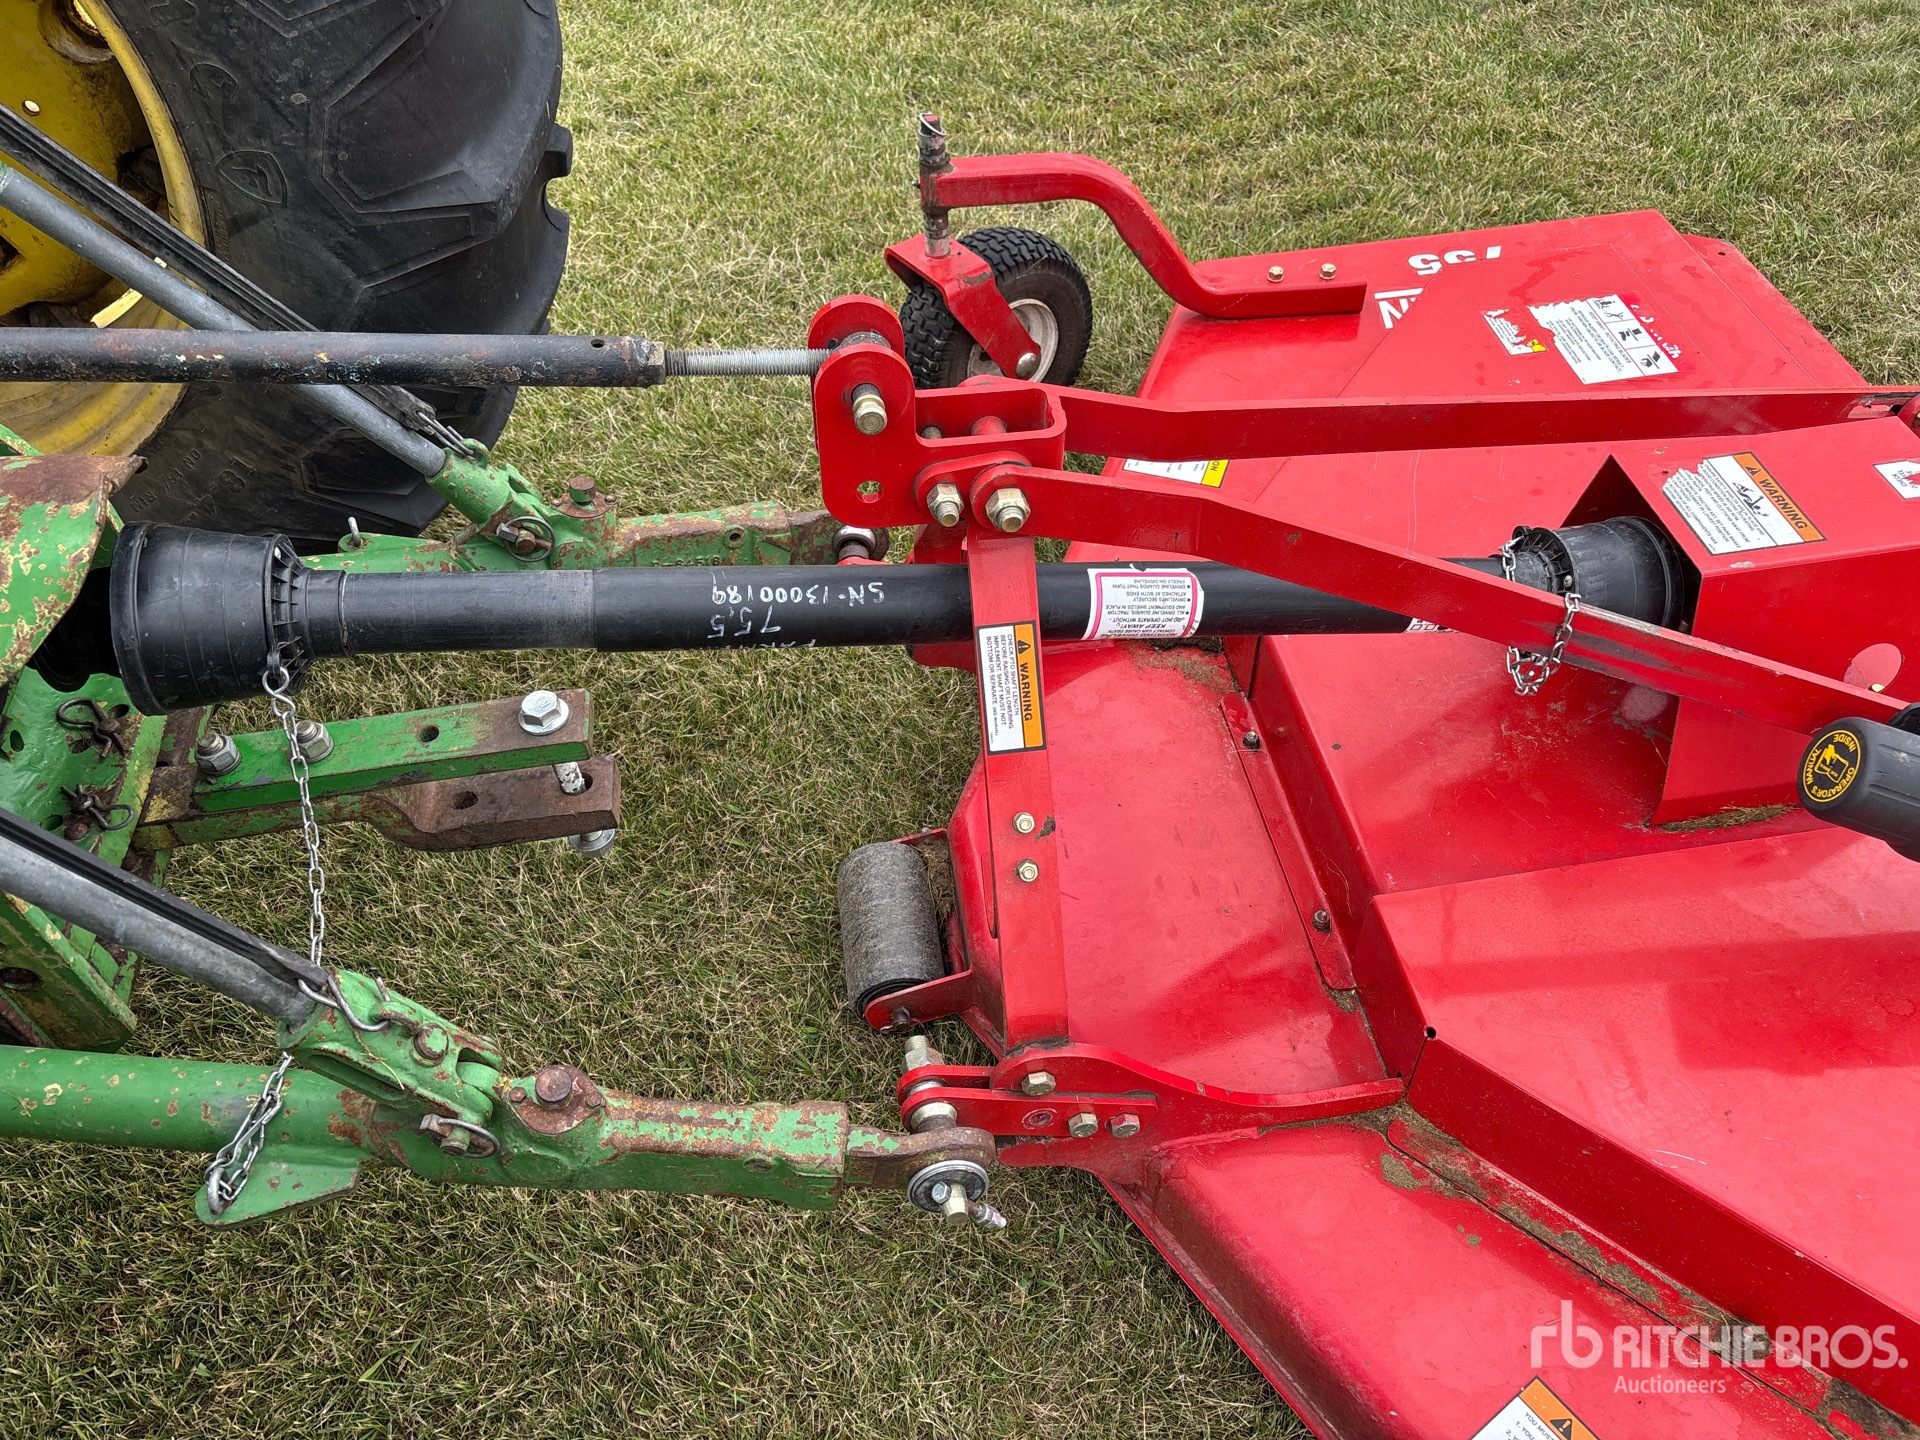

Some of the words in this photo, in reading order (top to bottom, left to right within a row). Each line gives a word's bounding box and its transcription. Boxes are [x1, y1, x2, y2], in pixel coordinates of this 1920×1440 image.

[1757, 478, 1809, 529] WARNING
[989, 664, 994, 673] OR
[1005, 687, 1011, 695] OR
[1020, 662, 1033, 721] WARNING
[1833, 734, 1857, 752] INSIDE
[1806, 748, 1822, 785] MANUAL
[1811, 767, 1855, 798] OPERATOR'S
[1525, 1412, 1538, 1426] YOU
